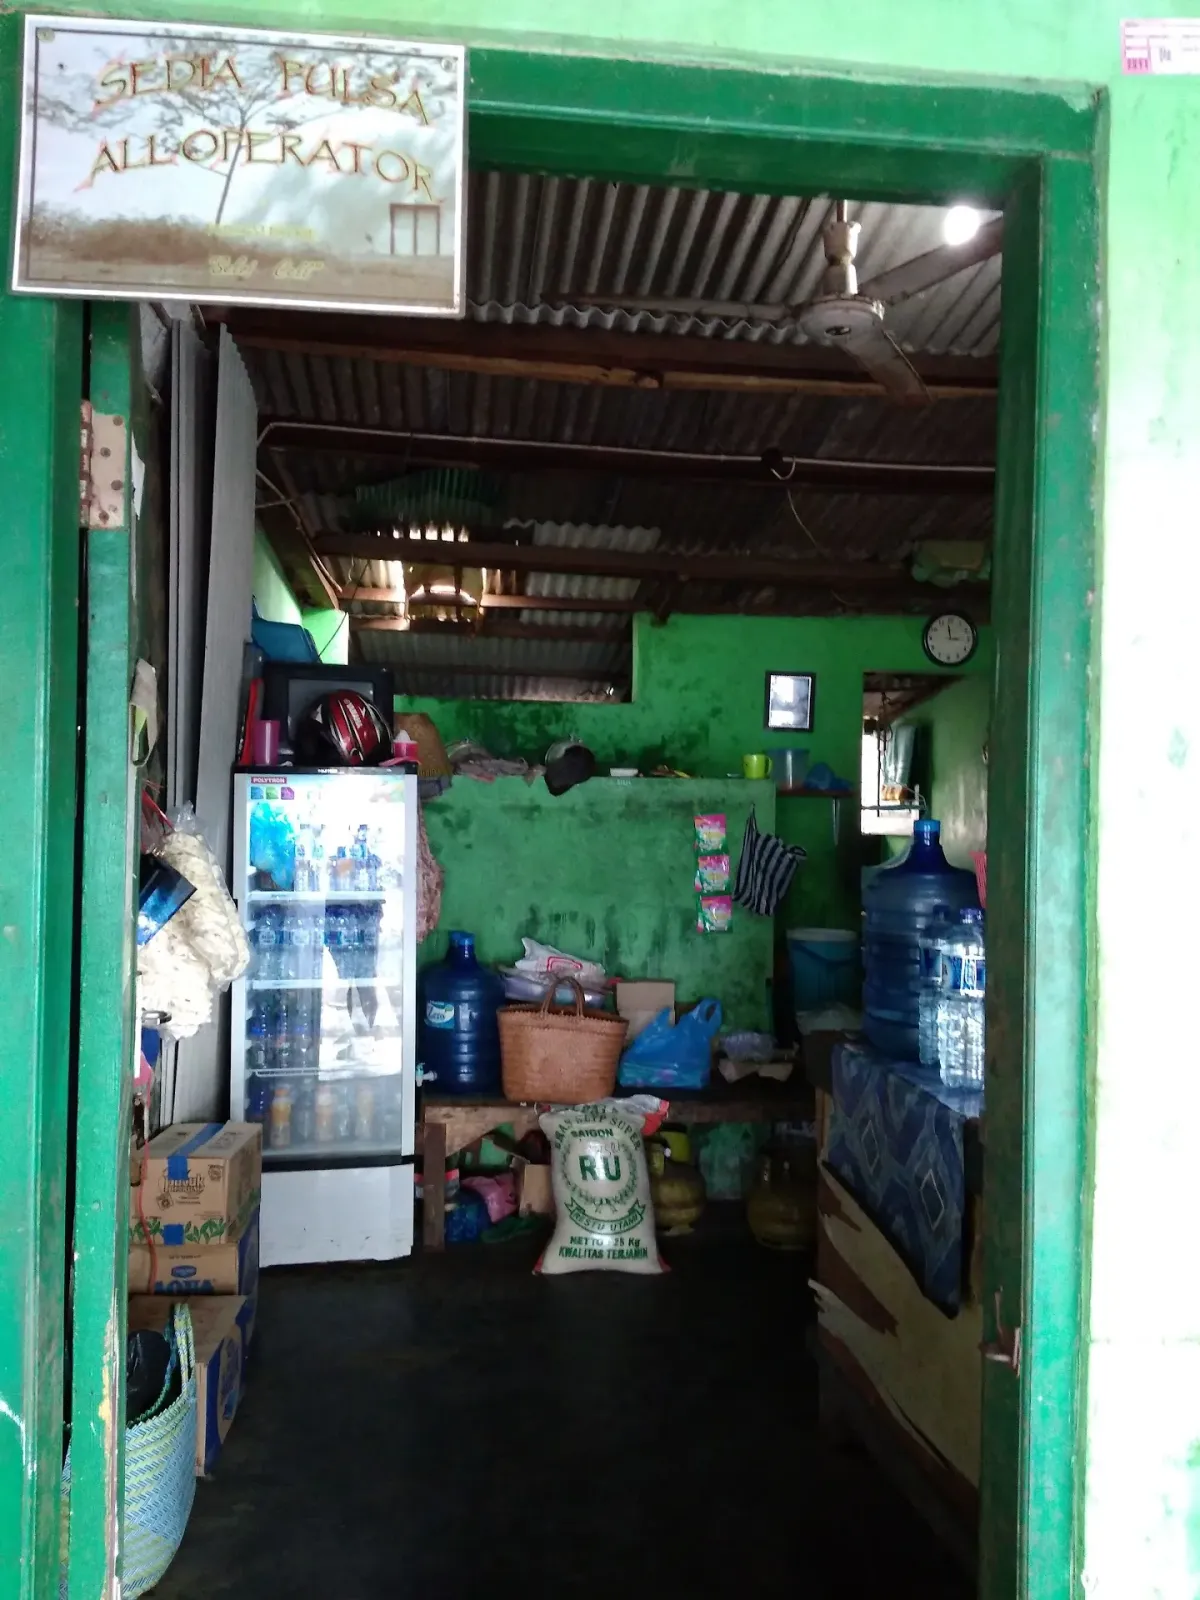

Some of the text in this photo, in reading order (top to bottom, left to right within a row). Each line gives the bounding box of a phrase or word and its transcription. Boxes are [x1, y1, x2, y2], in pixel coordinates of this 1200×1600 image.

[94, 53, 430, 125] SEDIA PULSA
[571, 1128, 614, 1139] SAIGON
[610, 1117, 642, 1151] SUPER
[579, 1154, 622, 1182] RU
[569, 1235, 604, 1246] NETTO
[559, 1246, 604, 1259] KWALITAS
